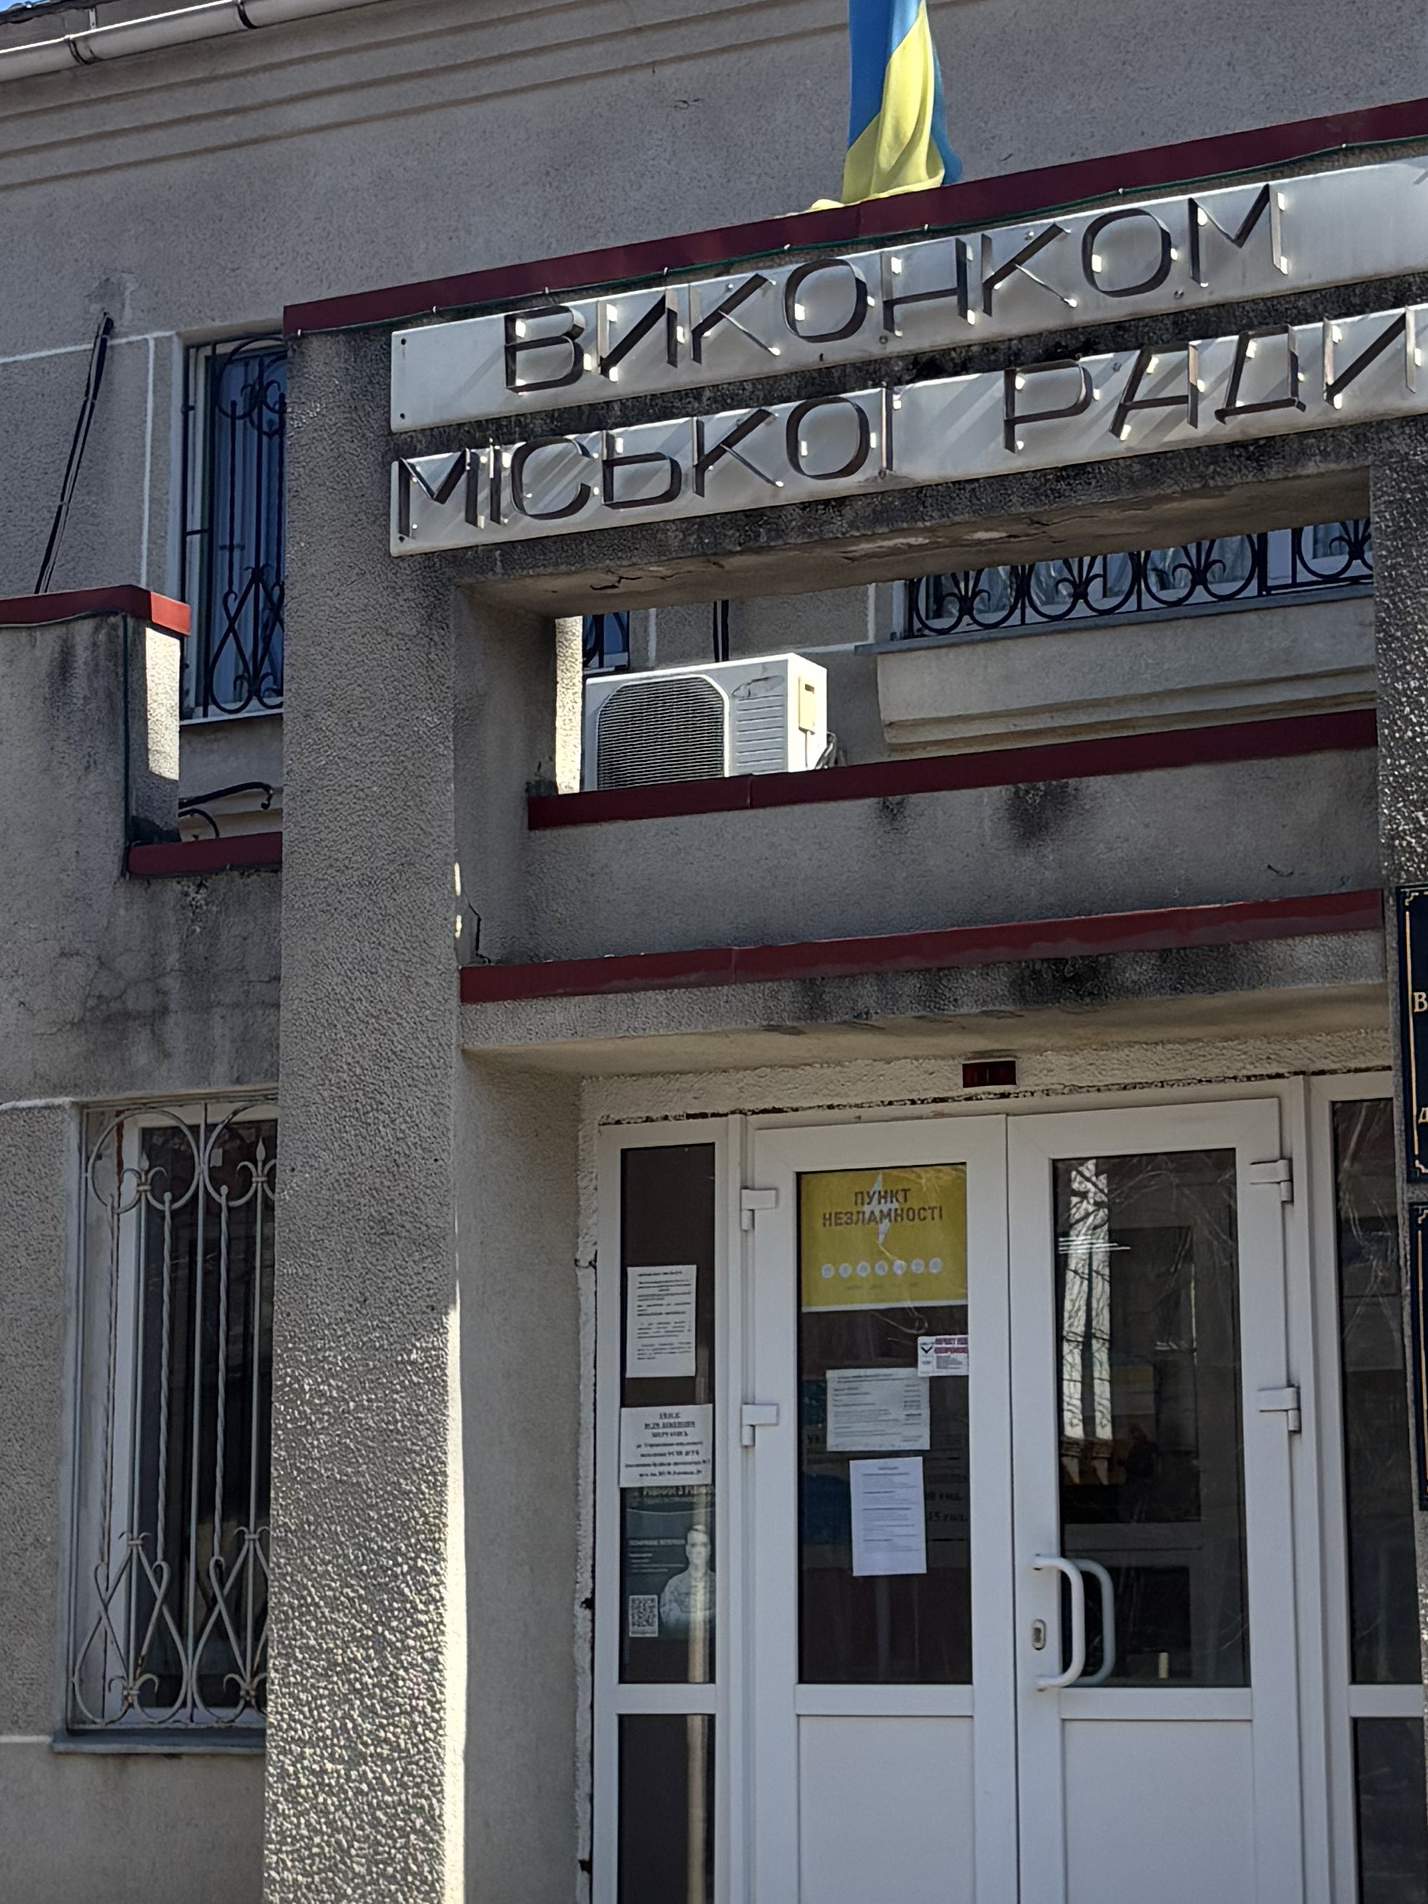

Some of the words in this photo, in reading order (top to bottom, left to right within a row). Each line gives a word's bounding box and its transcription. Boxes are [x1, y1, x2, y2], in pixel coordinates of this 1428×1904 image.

[504, 183, 1289, 394] ВИКОНКОМ
[1003, 305, 1417, 453] РАДИ
[822, 1206, 943, 1227] НЕЗЛАМНОСТІ
[854, 1188, 911, 1206] ПУНКТ
